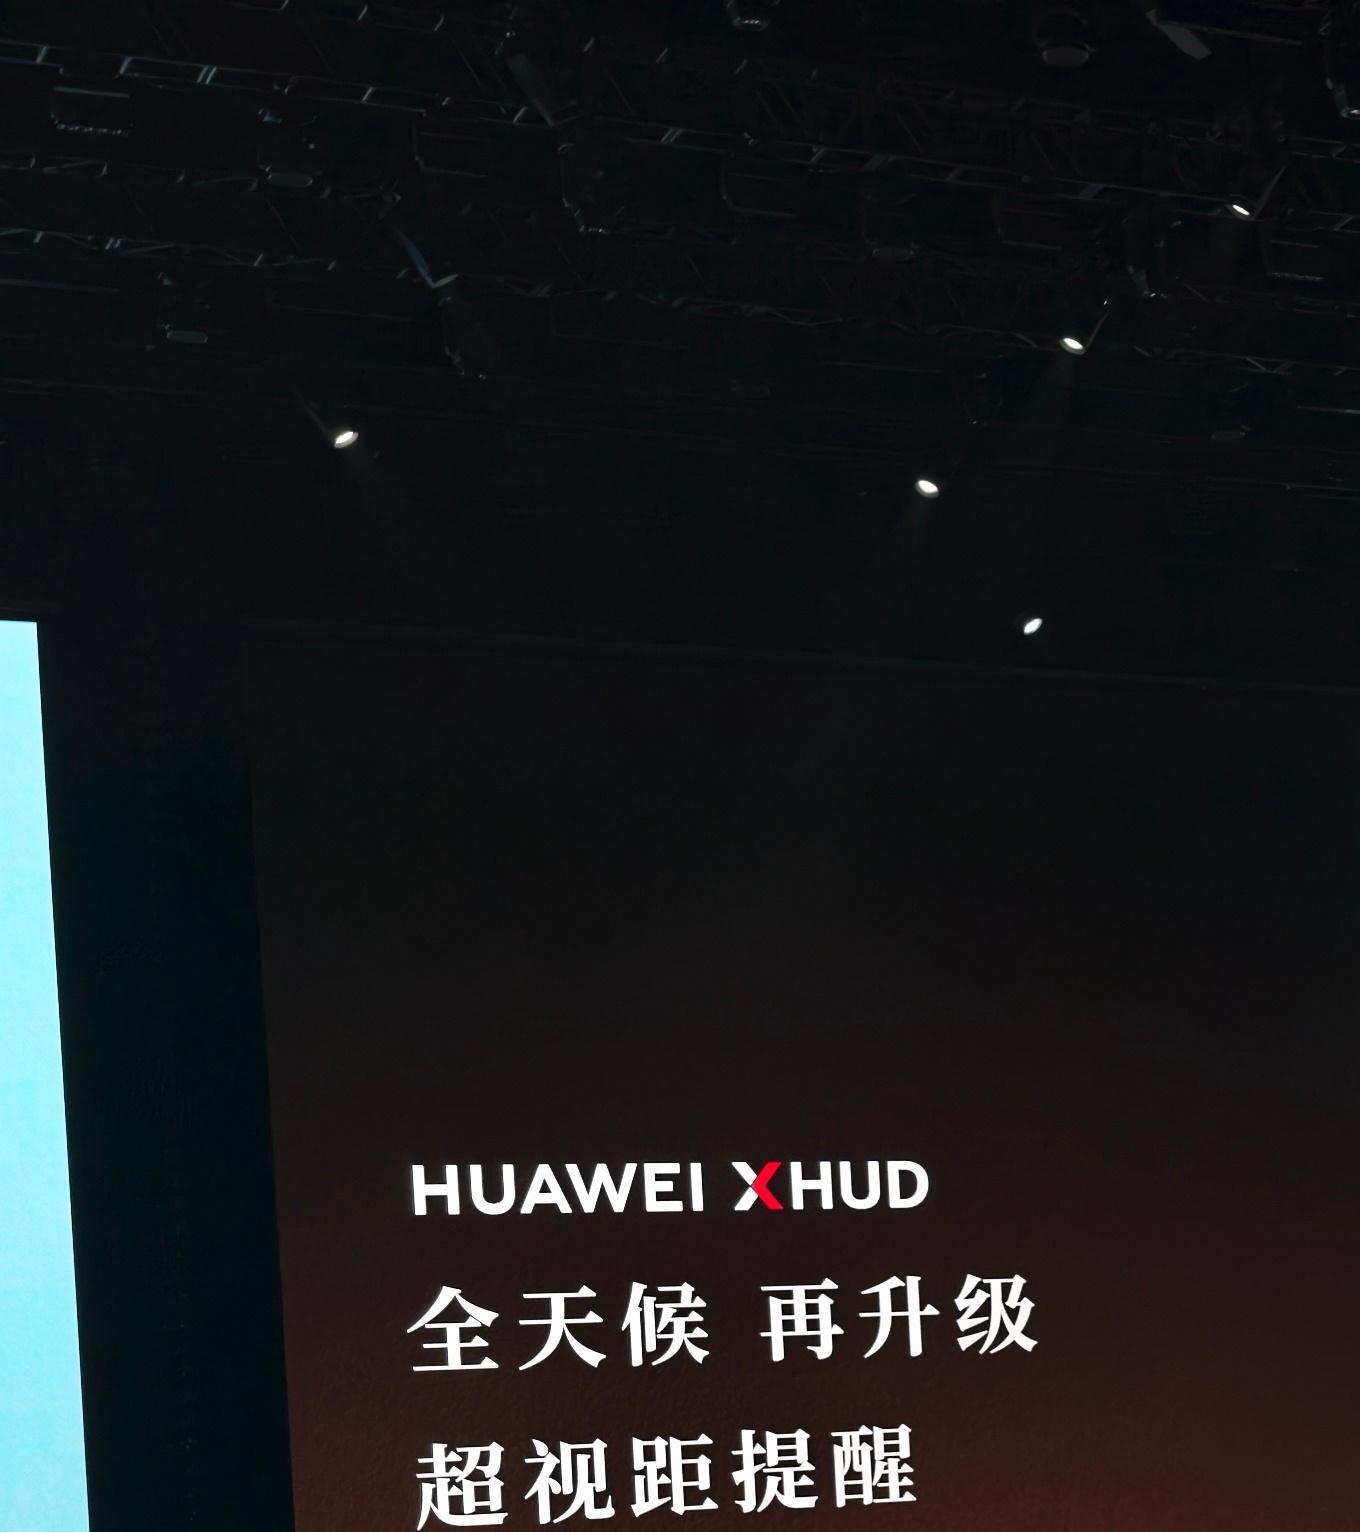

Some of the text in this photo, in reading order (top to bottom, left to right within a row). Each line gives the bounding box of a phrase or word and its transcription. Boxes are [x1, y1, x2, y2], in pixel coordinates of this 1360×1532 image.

[411, 1160, 929, 1216] HUAWEI XHUD
[407, 1273, 1039, 1372] 全天候 再升级
[416, 1423, 917, 1532] 超视距提醒
